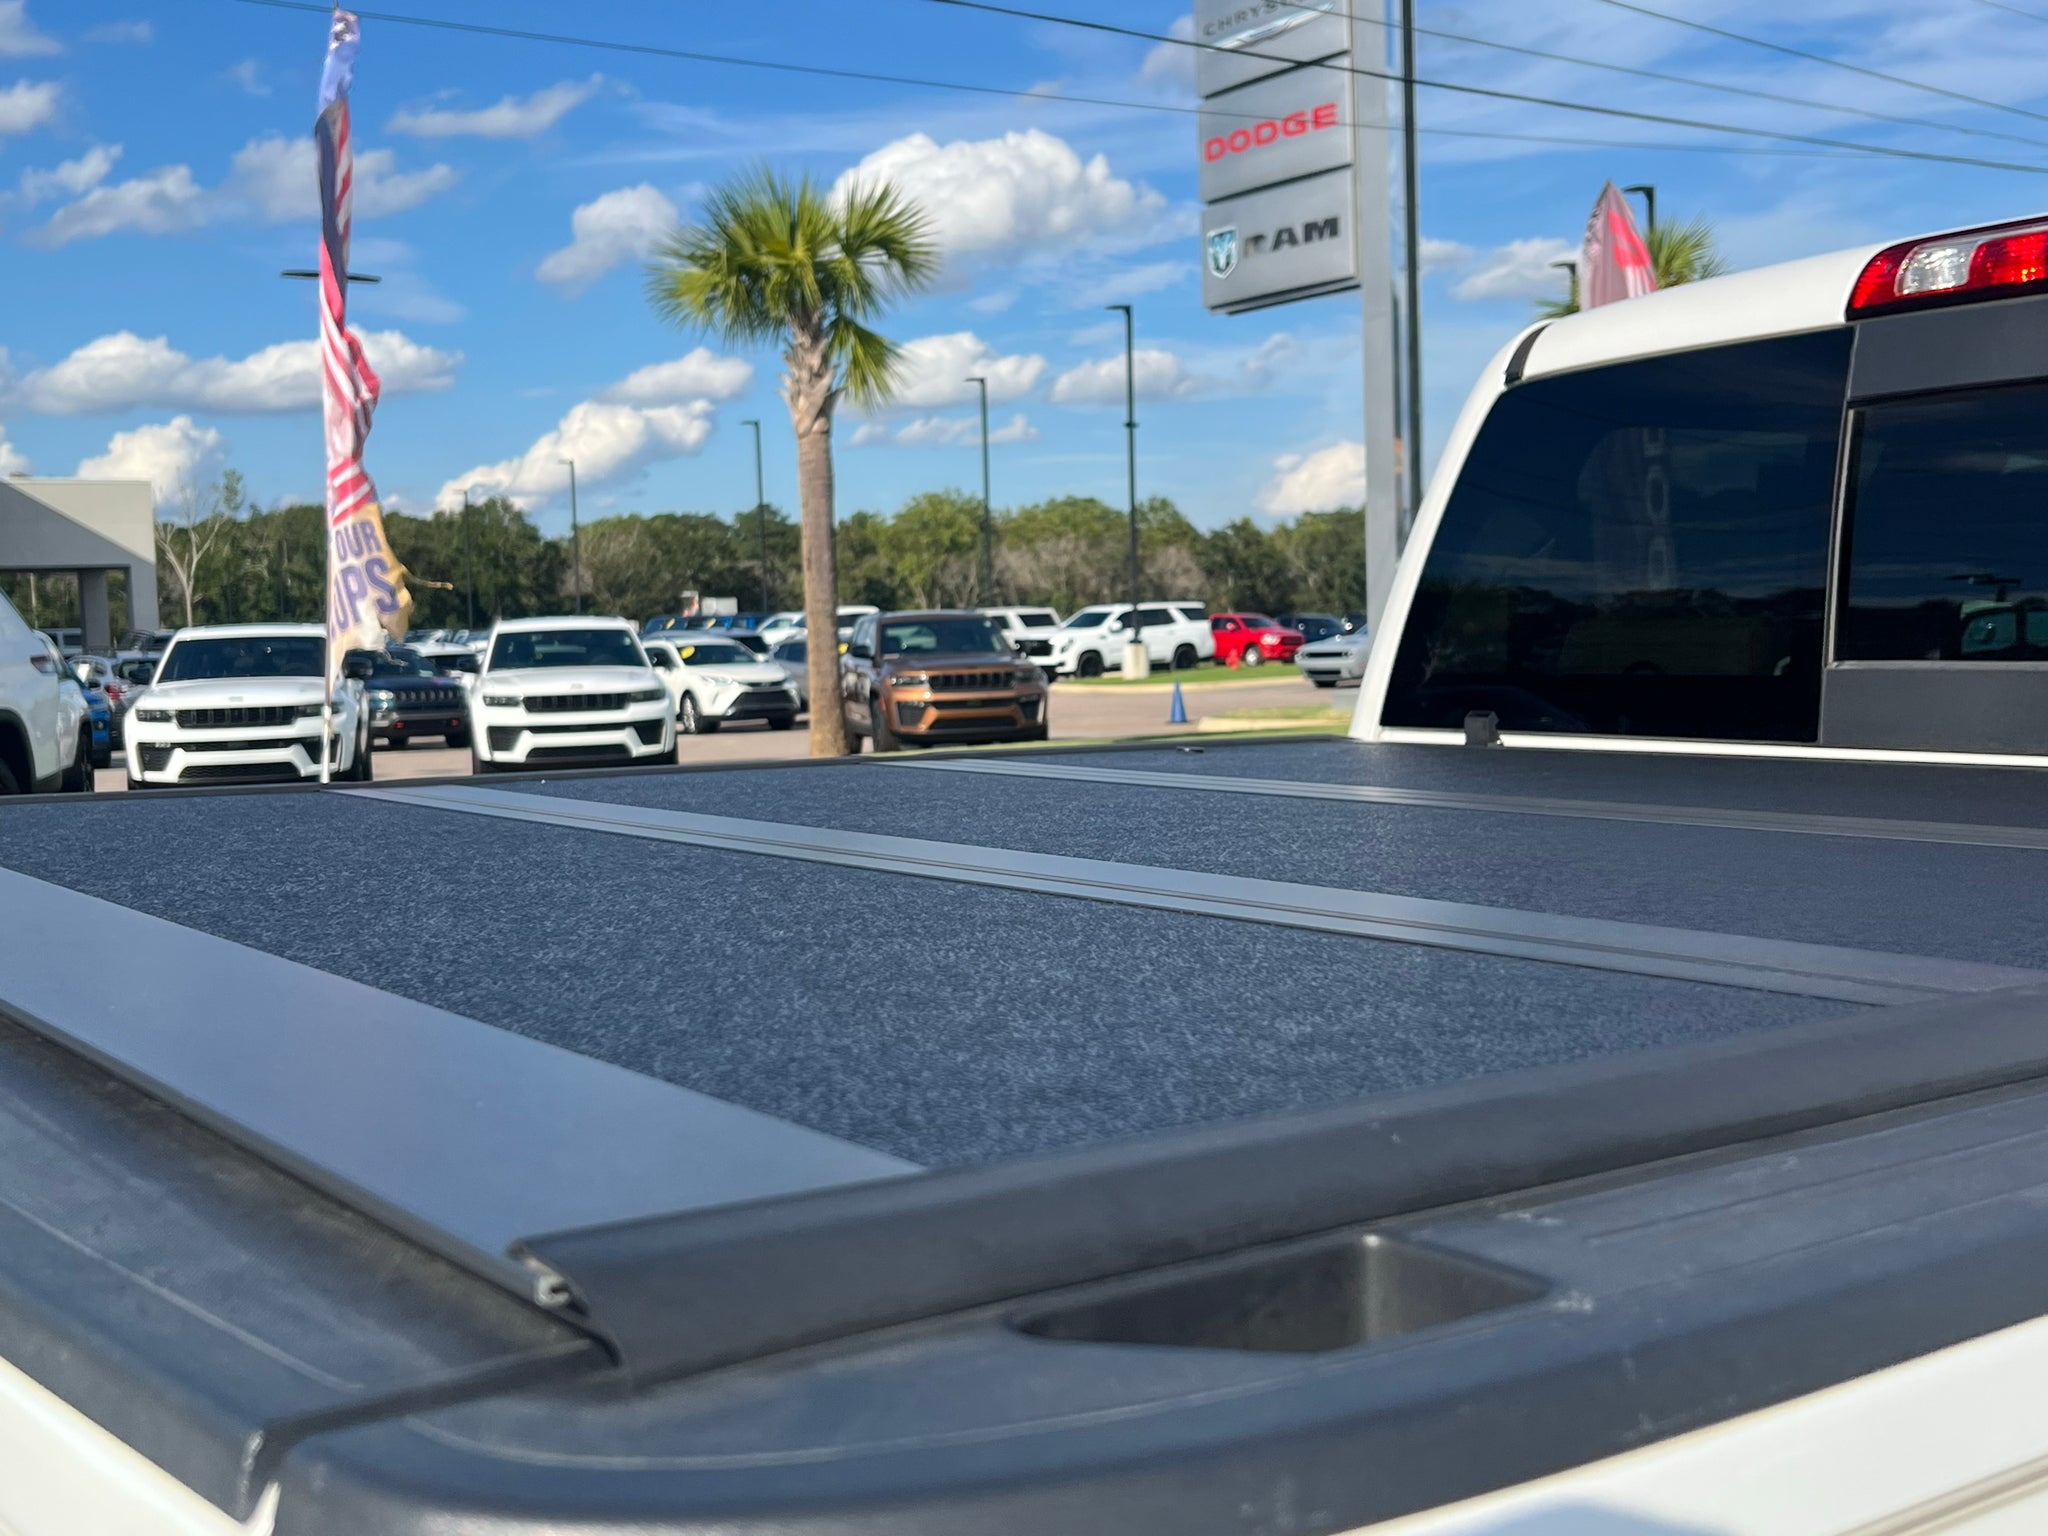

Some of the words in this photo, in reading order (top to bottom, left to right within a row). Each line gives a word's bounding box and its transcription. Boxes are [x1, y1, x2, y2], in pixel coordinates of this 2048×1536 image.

[1202, 0, 1288, 36] CHRYS
[1204, 102, 1338, 163] DODGE
[334, 519, 382, 562] OUR
